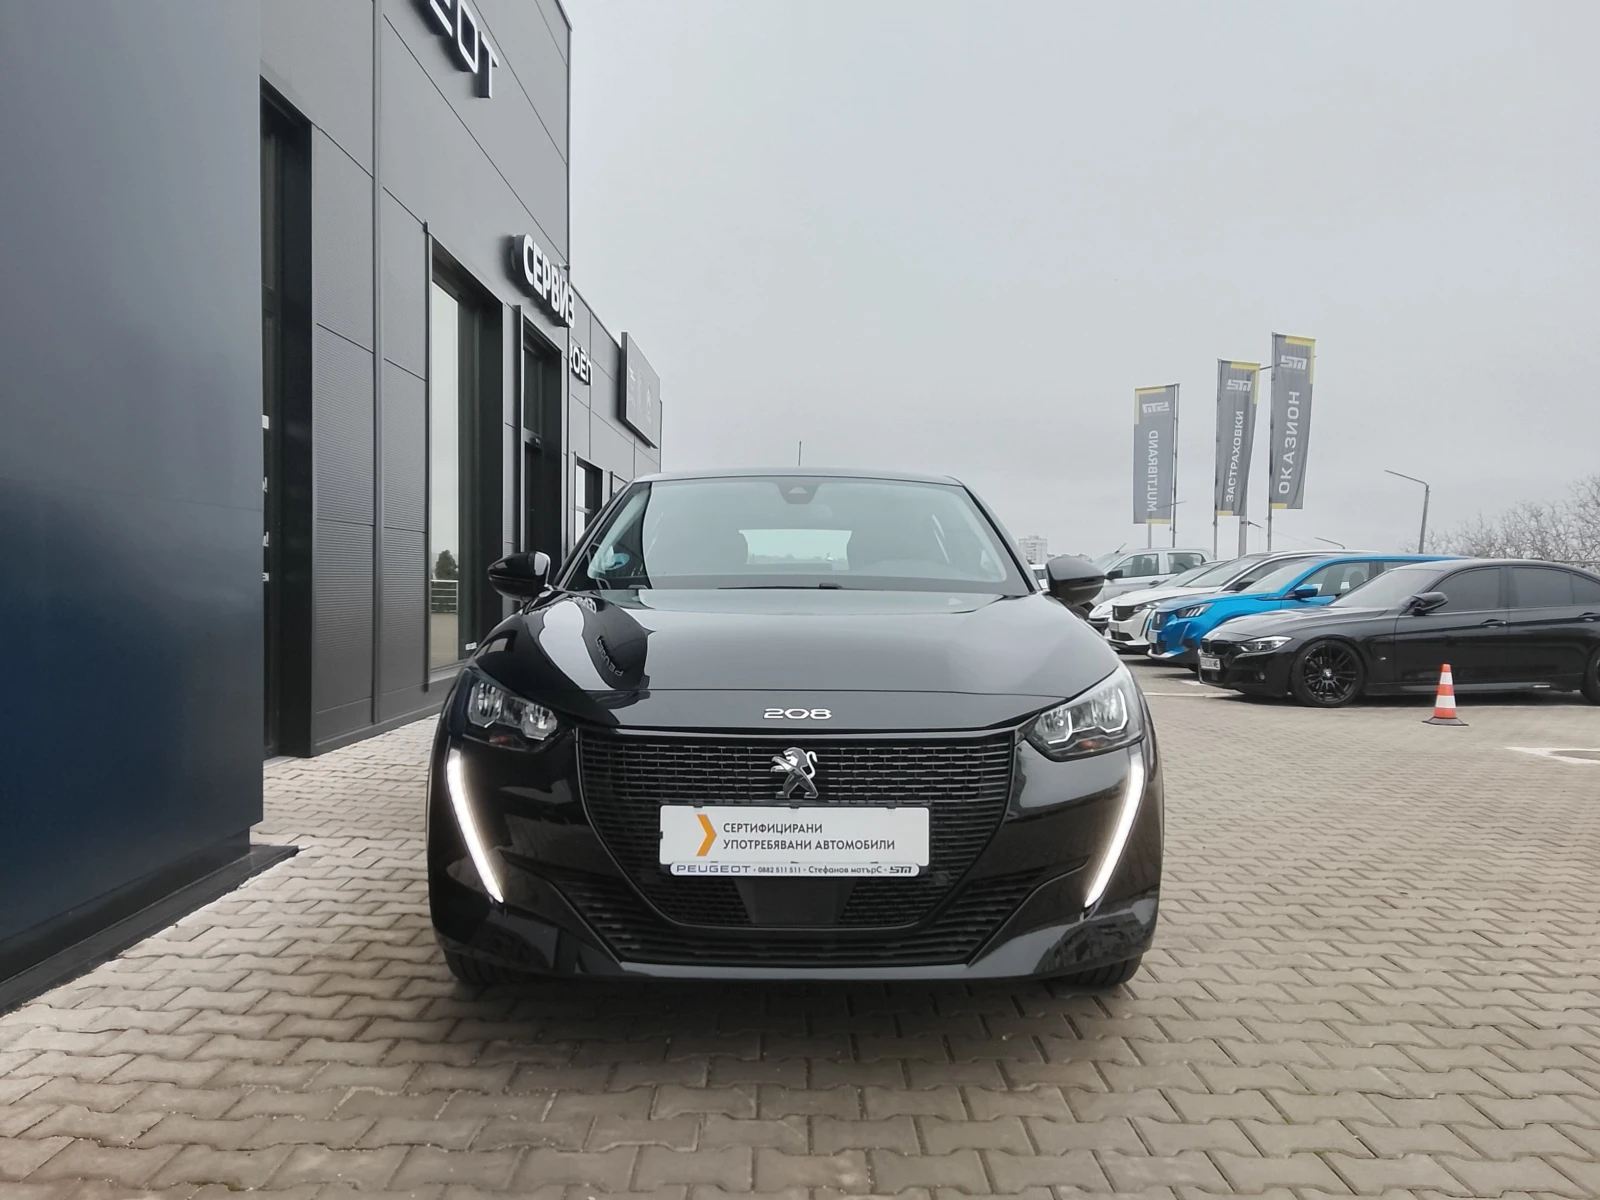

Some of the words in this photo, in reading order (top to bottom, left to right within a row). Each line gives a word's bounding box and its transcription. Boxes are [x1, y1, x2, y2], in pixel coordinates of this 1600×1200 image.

[523, 234, 575, 328] СЕРВИЗ
[1278, 391, 1300, 494] ОКАЗИОН
[1226, 411, 1244, 502] ЗАСТРАХОВКИ
[764, 708, 832, 720] 208
[723, 823, 823, 835] СЕРТИФИЦИРАНИ
[723, 839, 812, 851] УПОТРЕБЯВАНИ
[815, 839, 895, 850] АВТОМОБИЛИ
[676, 865, 751, 873] PEUGEOT
[808, 866, 849, 875] Стефанов
